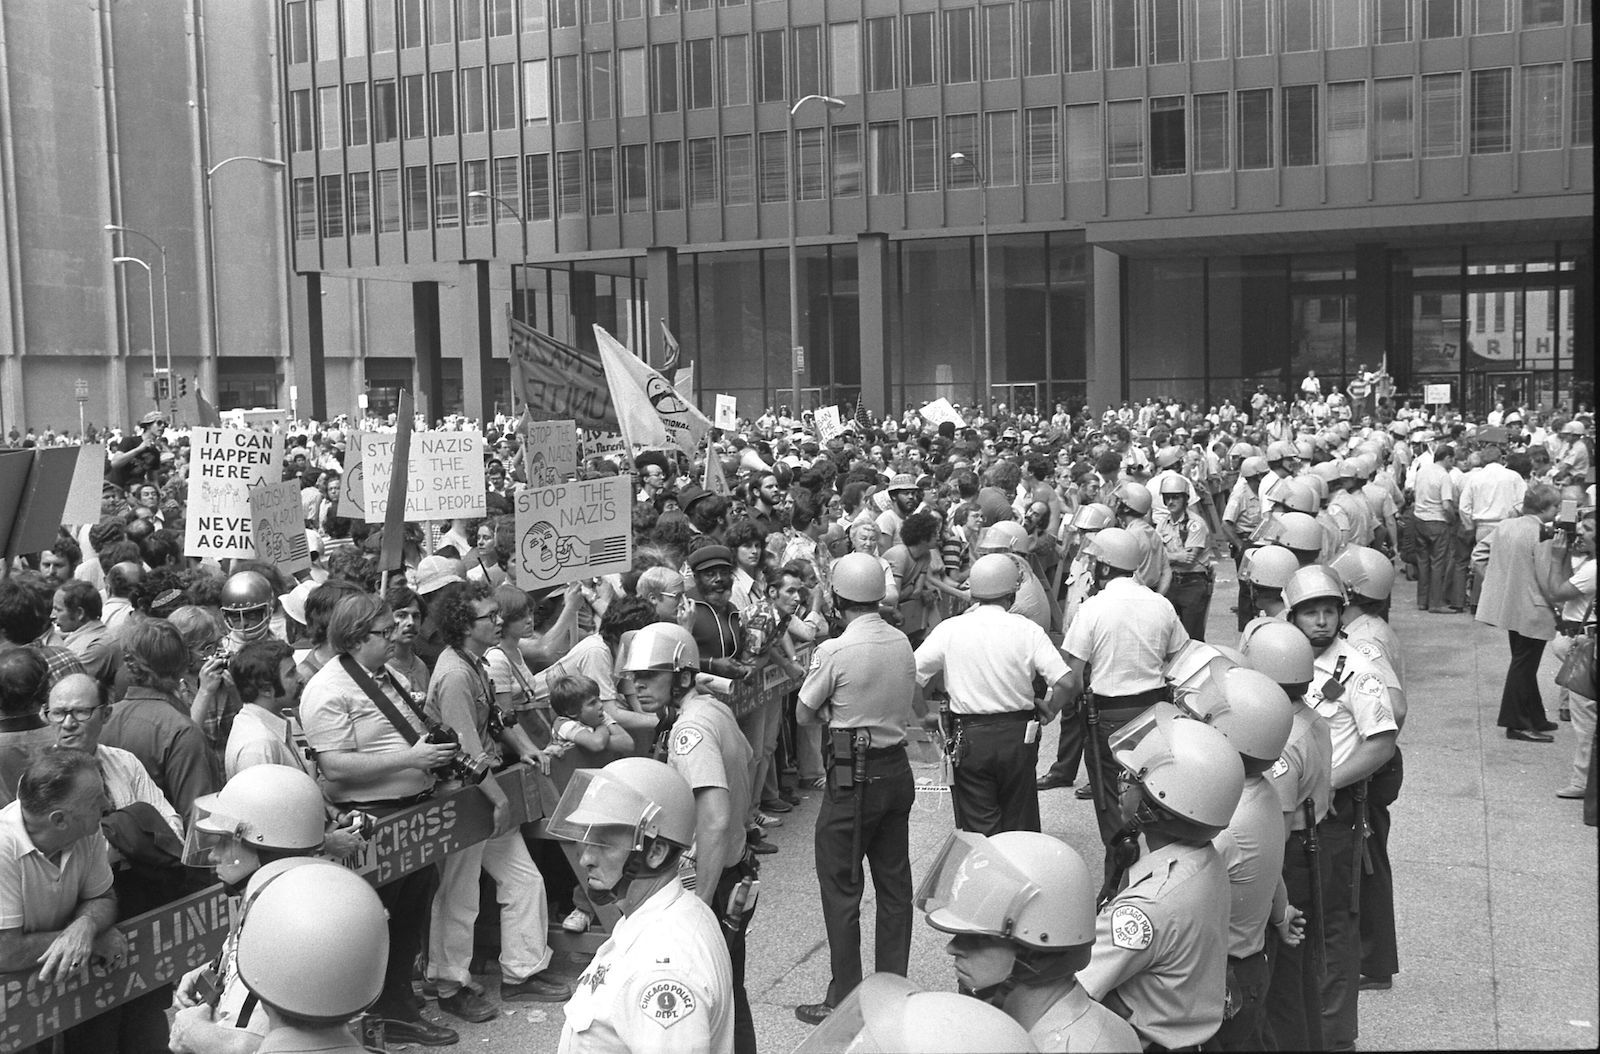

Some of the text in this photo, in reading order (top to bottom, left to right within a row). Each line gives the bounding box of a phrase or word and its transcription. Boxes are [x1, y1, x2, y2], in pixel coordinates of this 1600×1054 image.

[206, 431, 273, 449] IT CAN
[529, 426, 552, 446] STOP
[421, 437, 474, 454] NAZIS
[200, 448, 271, 465] HAPPEN
[202, 464, 251, 479] HERE
[372, 457, 464, 475] MAE THE
[432, 475, 471, 491] SAFE
[405, 498, 433, 512] ALL
[438, 494, 485, 510] PEOPLE
[518, 482, 614, 512] STOP THE
[560, 502, 616, 528] NAZIS
[199, 517, 252, 532] NEVE
[152, 893, 230, 955] LINE
[376, 800, 457, 856] CROSS
[1115, 907, 1152, 946] CHICAGO POLICE
[0, 834, 460, 1051] CHICAGO DEPT.
[641, 983, 693, 1010] CHICAGO POLICE
